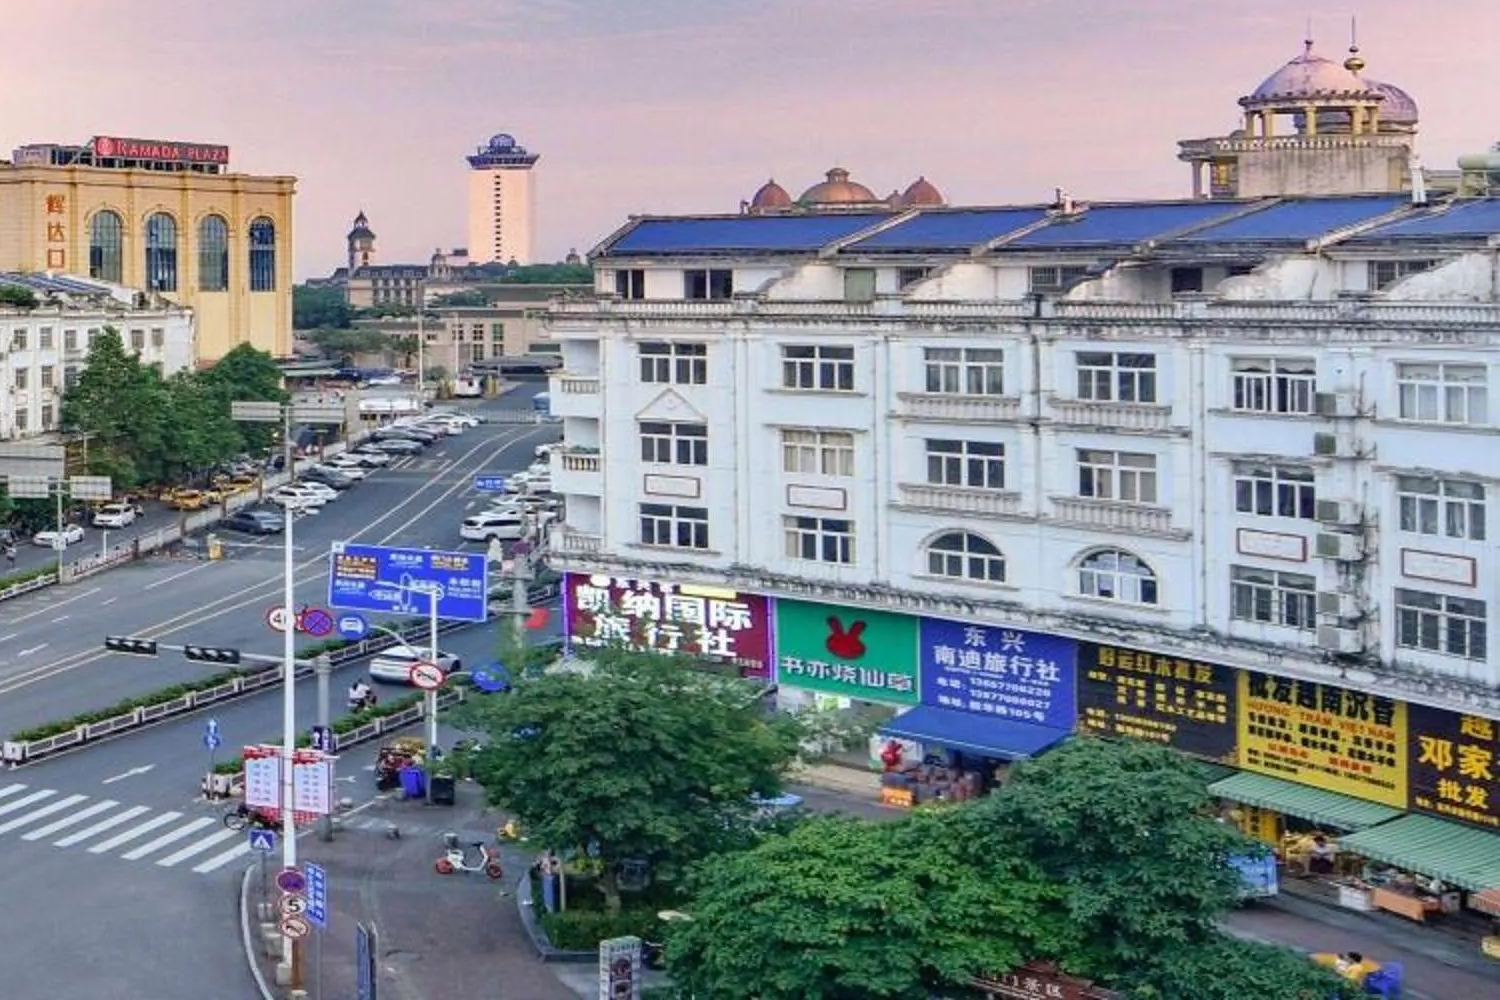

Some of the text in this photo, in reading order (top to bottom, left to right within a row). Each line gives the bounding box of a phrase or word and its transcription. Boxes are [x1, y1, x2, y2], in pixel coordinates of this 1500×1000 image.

[118, 141, 228, 162] RAMADA PLAZA
[575, 584, 753, 630] 凯纳国际
[592, 614, 737, 657] 旅行社
[964, 626, 1026, 652] 东兴
[933, 644, 1061, 682] 南迪旅行社
[1418, 735, 1500, 780] 邓家
[1437, 778, 1489, 809] 批发
[288, 898, 301, 912] 5
